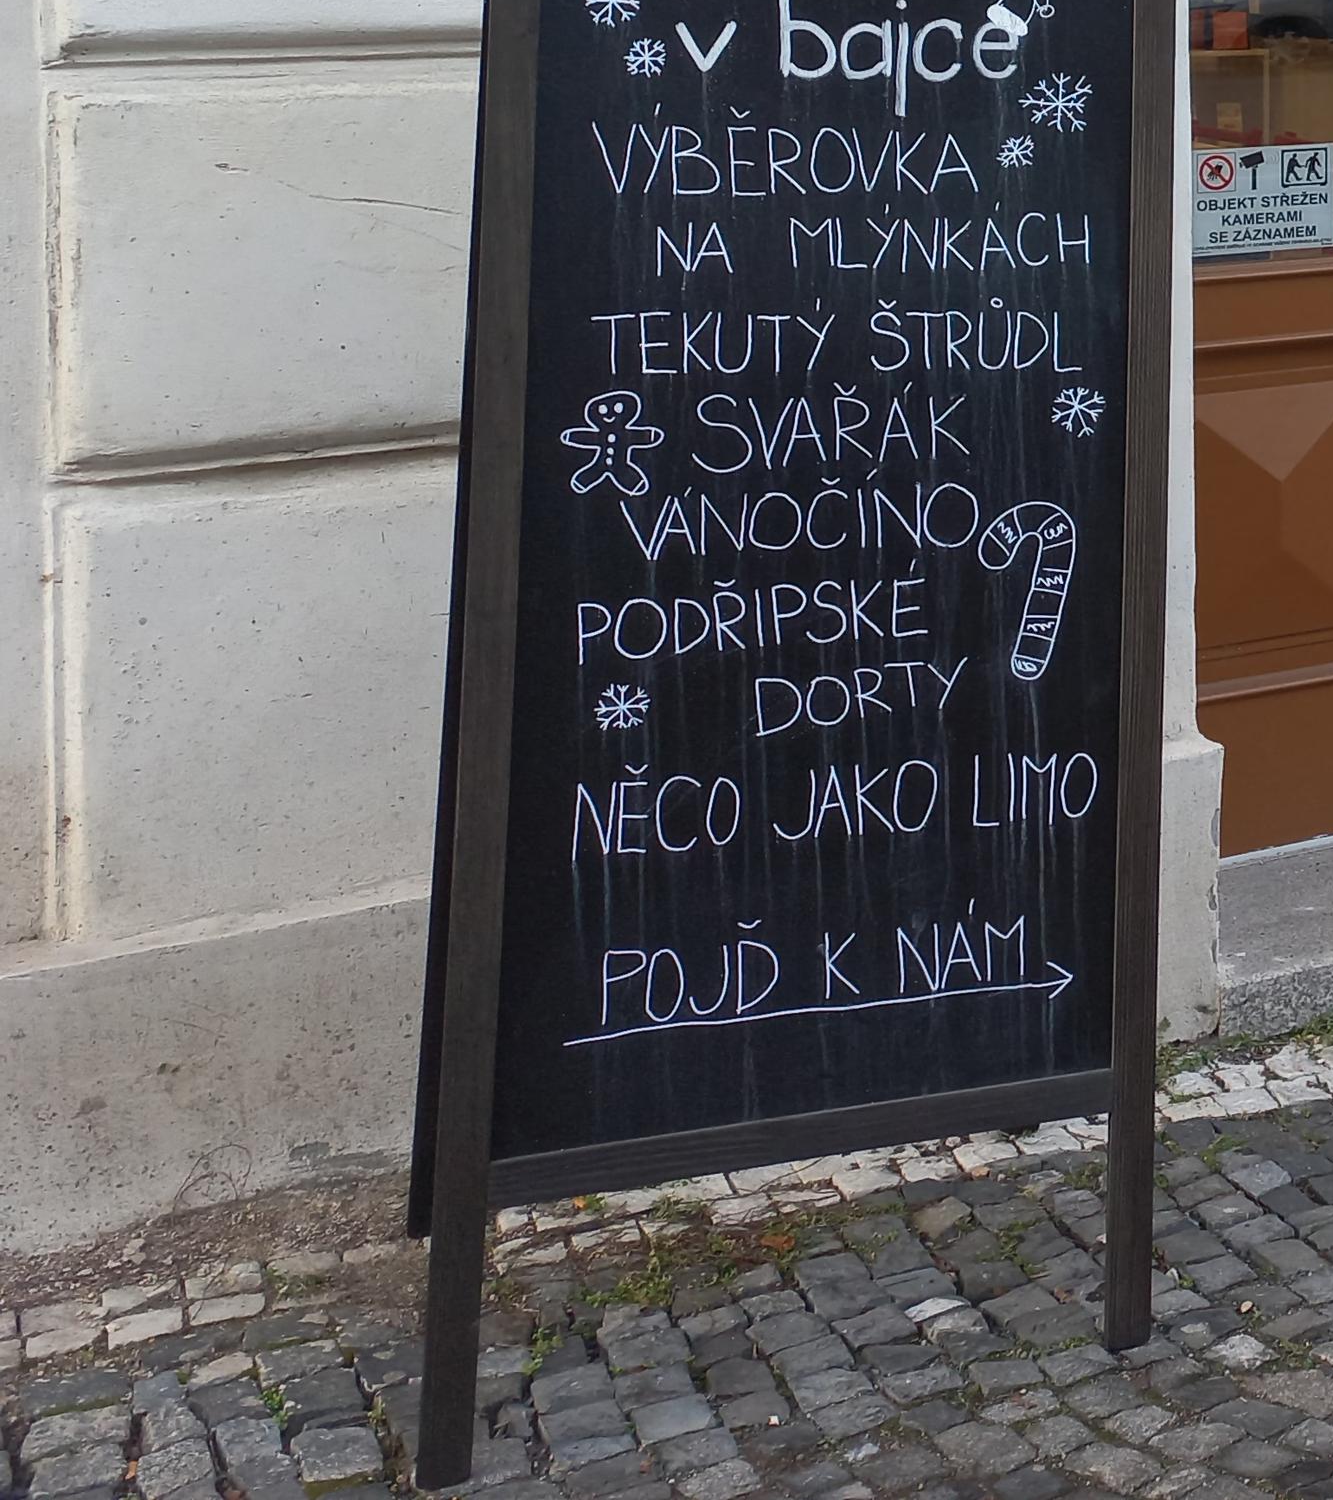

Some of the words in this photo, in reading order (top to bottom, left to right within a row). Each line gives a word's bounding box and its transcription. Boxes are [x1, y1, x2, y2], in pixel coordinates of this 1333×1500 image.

[676, 20, 736, 73] v
[592, 102, 979, 196] VÝBĚROVKA
[656, 220, 734, 276] NA
[789, 201, 1091, 272] MLÝNKÁCH
[1197, 197, 1257, 212] OBJEKT
[1260, 191, 1328, 208] STŘEŽEN
[1209, 231, 1229, 244] SE
[1232, 225, 1316, 242] ZÁZNAMEM
[1221, 210, 1302, 226] KAMERAMI
[591, 297, 836, 375] TEKUTÝ
[870, 297, 1083, 372] ŠTRŮDL
[692, 382, 970, 473] SVAŘÁK
[620, 469, 979, 560] VÁNOČÍNO
[577, 558, 929, 665] PODŘIPSKÉ
[755, 657, 968, 737] DORTY
[572, 763, 740, 862] NĚCO
[773, 758, 937, 840] JAKO
[973, 752, 1097, 826] LIMO
[601, 918, 779, 1025] POJĎ
[824, 931, 861, 999] K
[897, 898, 1026, 994] NÁM
